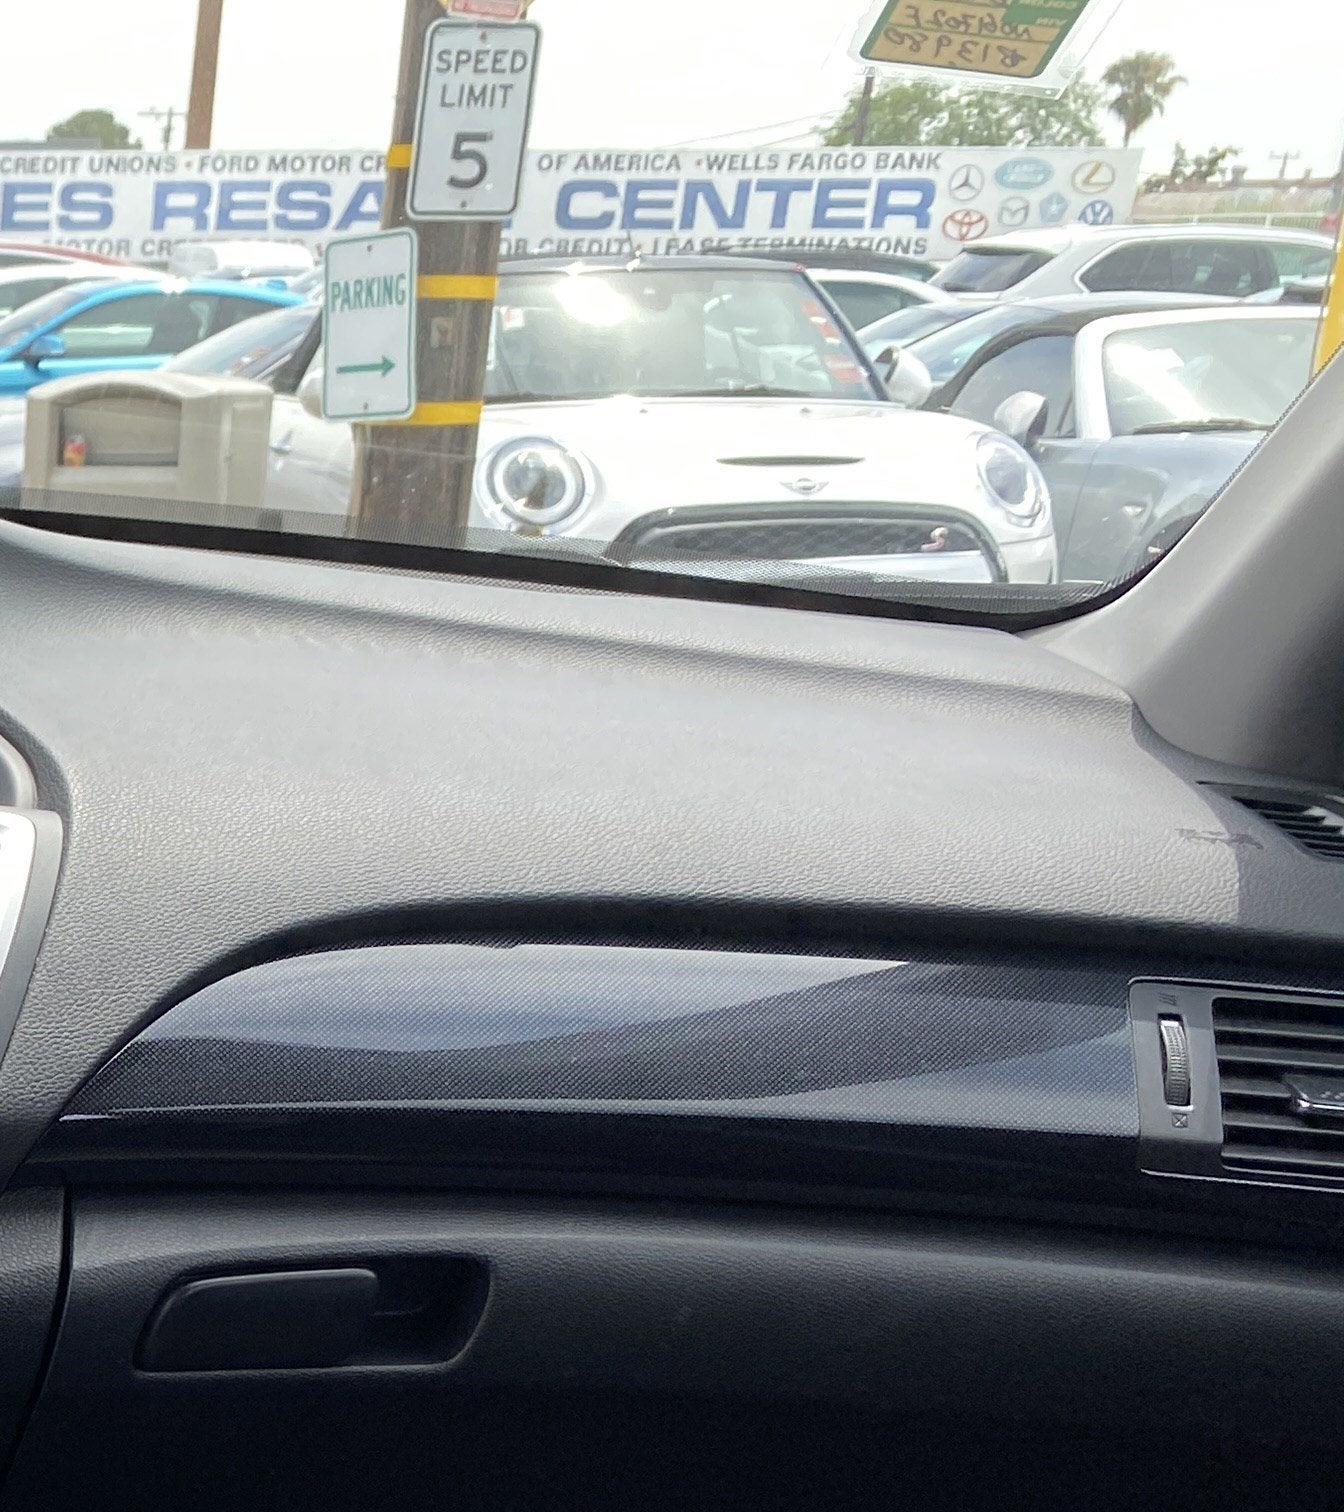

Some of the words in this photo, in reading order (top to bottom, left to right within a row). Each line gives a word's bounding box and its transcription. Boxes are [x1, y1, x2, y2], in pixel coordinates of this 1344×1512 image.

[436, 49, 527, 74] SPEED
[440, 83, 514, 108] LIMIT
[0, 155, 81, 174] CREDIT
[89, 155, 178, 174] UNIONS
[197, 154, 259, 174] FORD
[267, 154, 352, 173] MOTOR
[447, 131, 494, 189] 5
[537, 153, 568, 172] OF
[573, 152, 681, 172] AMERICA
[705, 151, 779, 171] WELLS
[786, 151, 866, 171] FARGO
[874, 151, 943, 171] BANK
[152, 179, 386, 232] RESA
[556, 177, 938, 231] CENTER
[330, 273, 406, 312] PARKING
